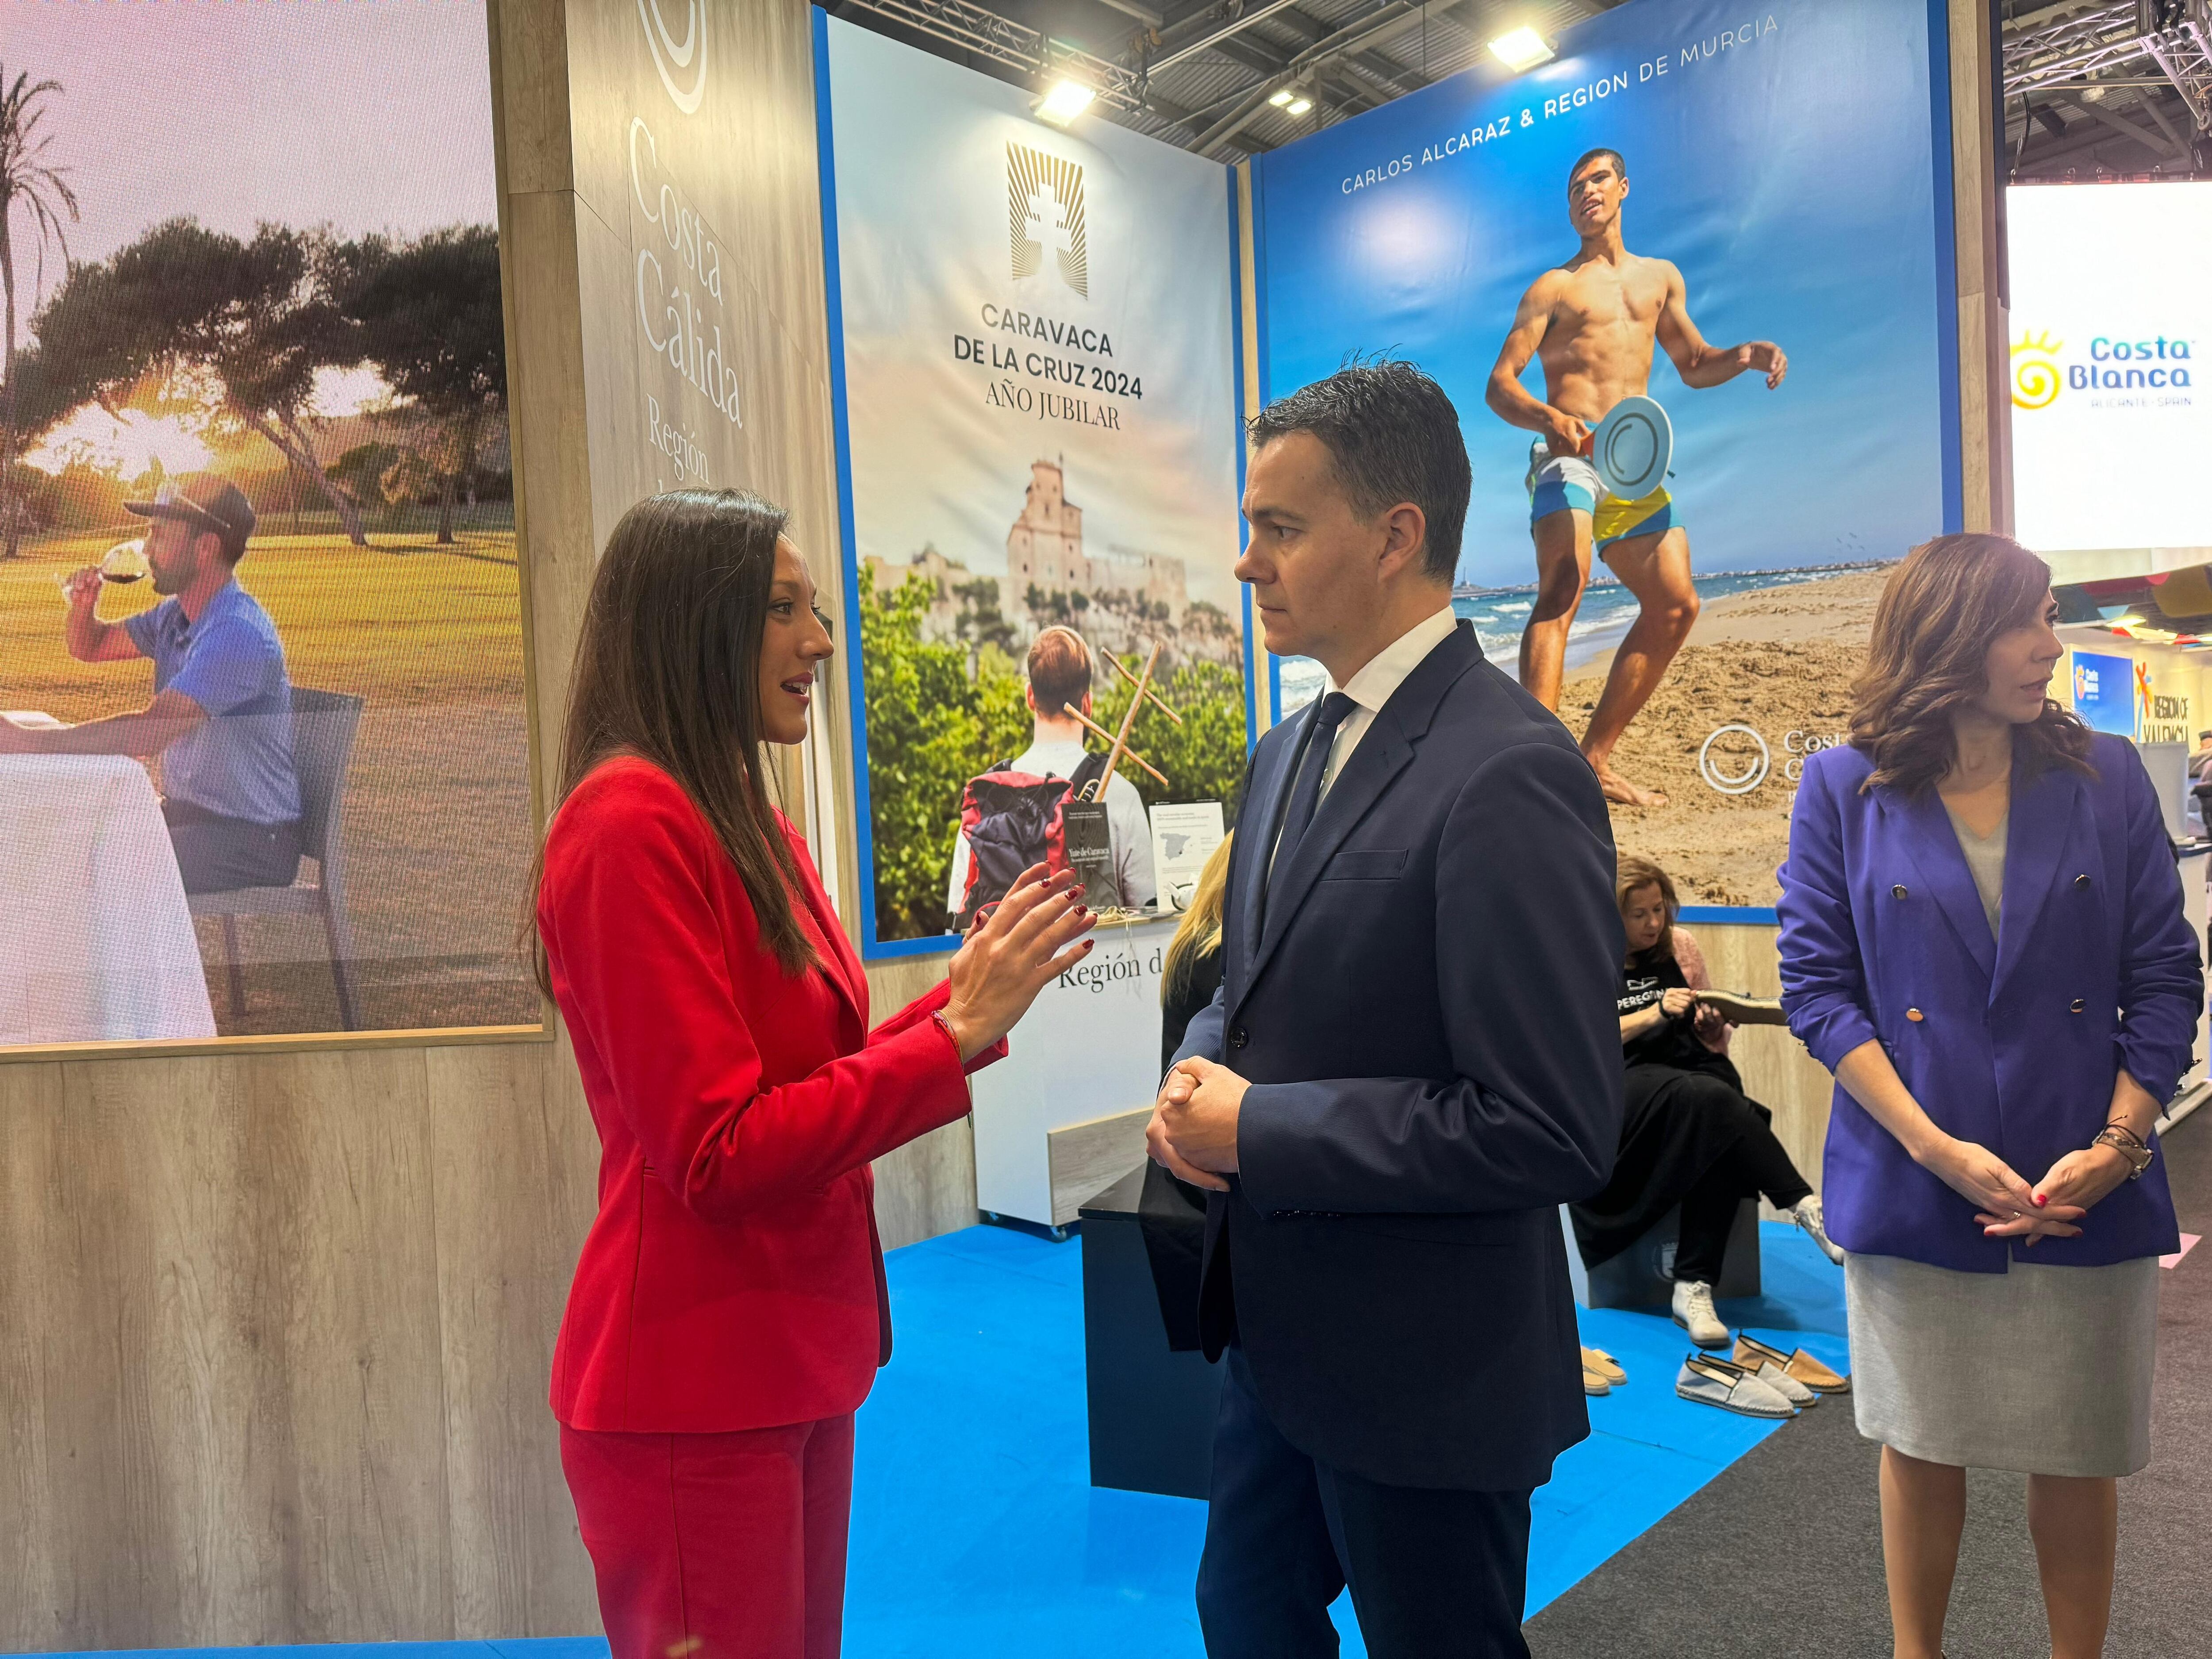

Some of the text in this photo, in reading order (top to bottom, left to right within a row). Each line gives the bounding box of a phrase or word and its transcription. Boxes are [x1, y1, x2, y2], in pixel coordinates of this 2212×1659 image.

[1342, 15, 1778, 194] CARLOS ALCARAZ & REGION DE MURCIA
[630, 116, 724, 306] Costa
[637, 248, 743, 429] Cálida
[981, 303, 1113, 357] CARAVACA
[2091, 335, 2191, 361] Costa
[954, 334, 1142, 399] DE LA CRUZ 2024
[2069, 365, 2192, 390] Blanca
[985, 378, 1121, 430] AÑO JUBILAR
[2158, 396, 2192, 407] SPAIN
[646, 392, 710, 485] Región
[1784, 730, 1840, 753] Cost
